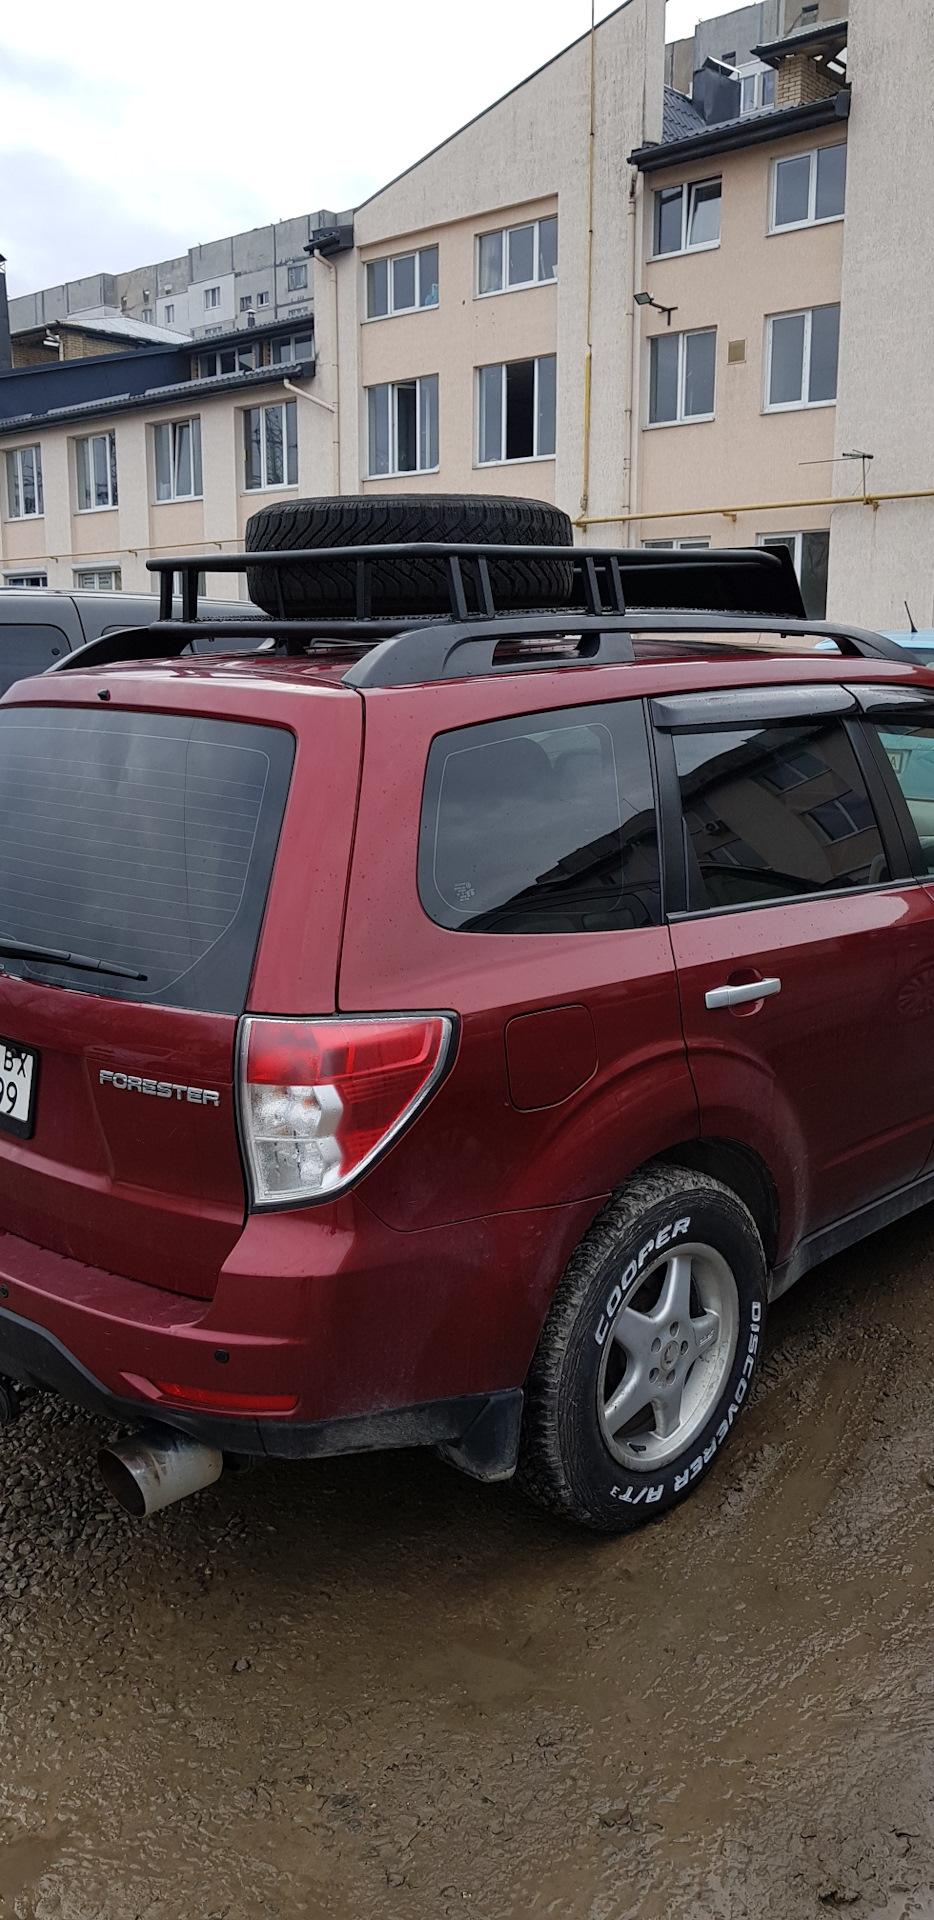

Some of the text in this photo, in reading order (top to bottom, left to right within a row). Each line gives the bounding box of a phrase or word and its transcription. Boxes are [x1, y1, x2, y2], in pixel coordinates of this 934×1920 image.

[99, 1069, 220, 1107] FORESTER
[594, 1216, 692, 1345] COOPER
[673, 1301, 762, 1492] DISCOVERER
